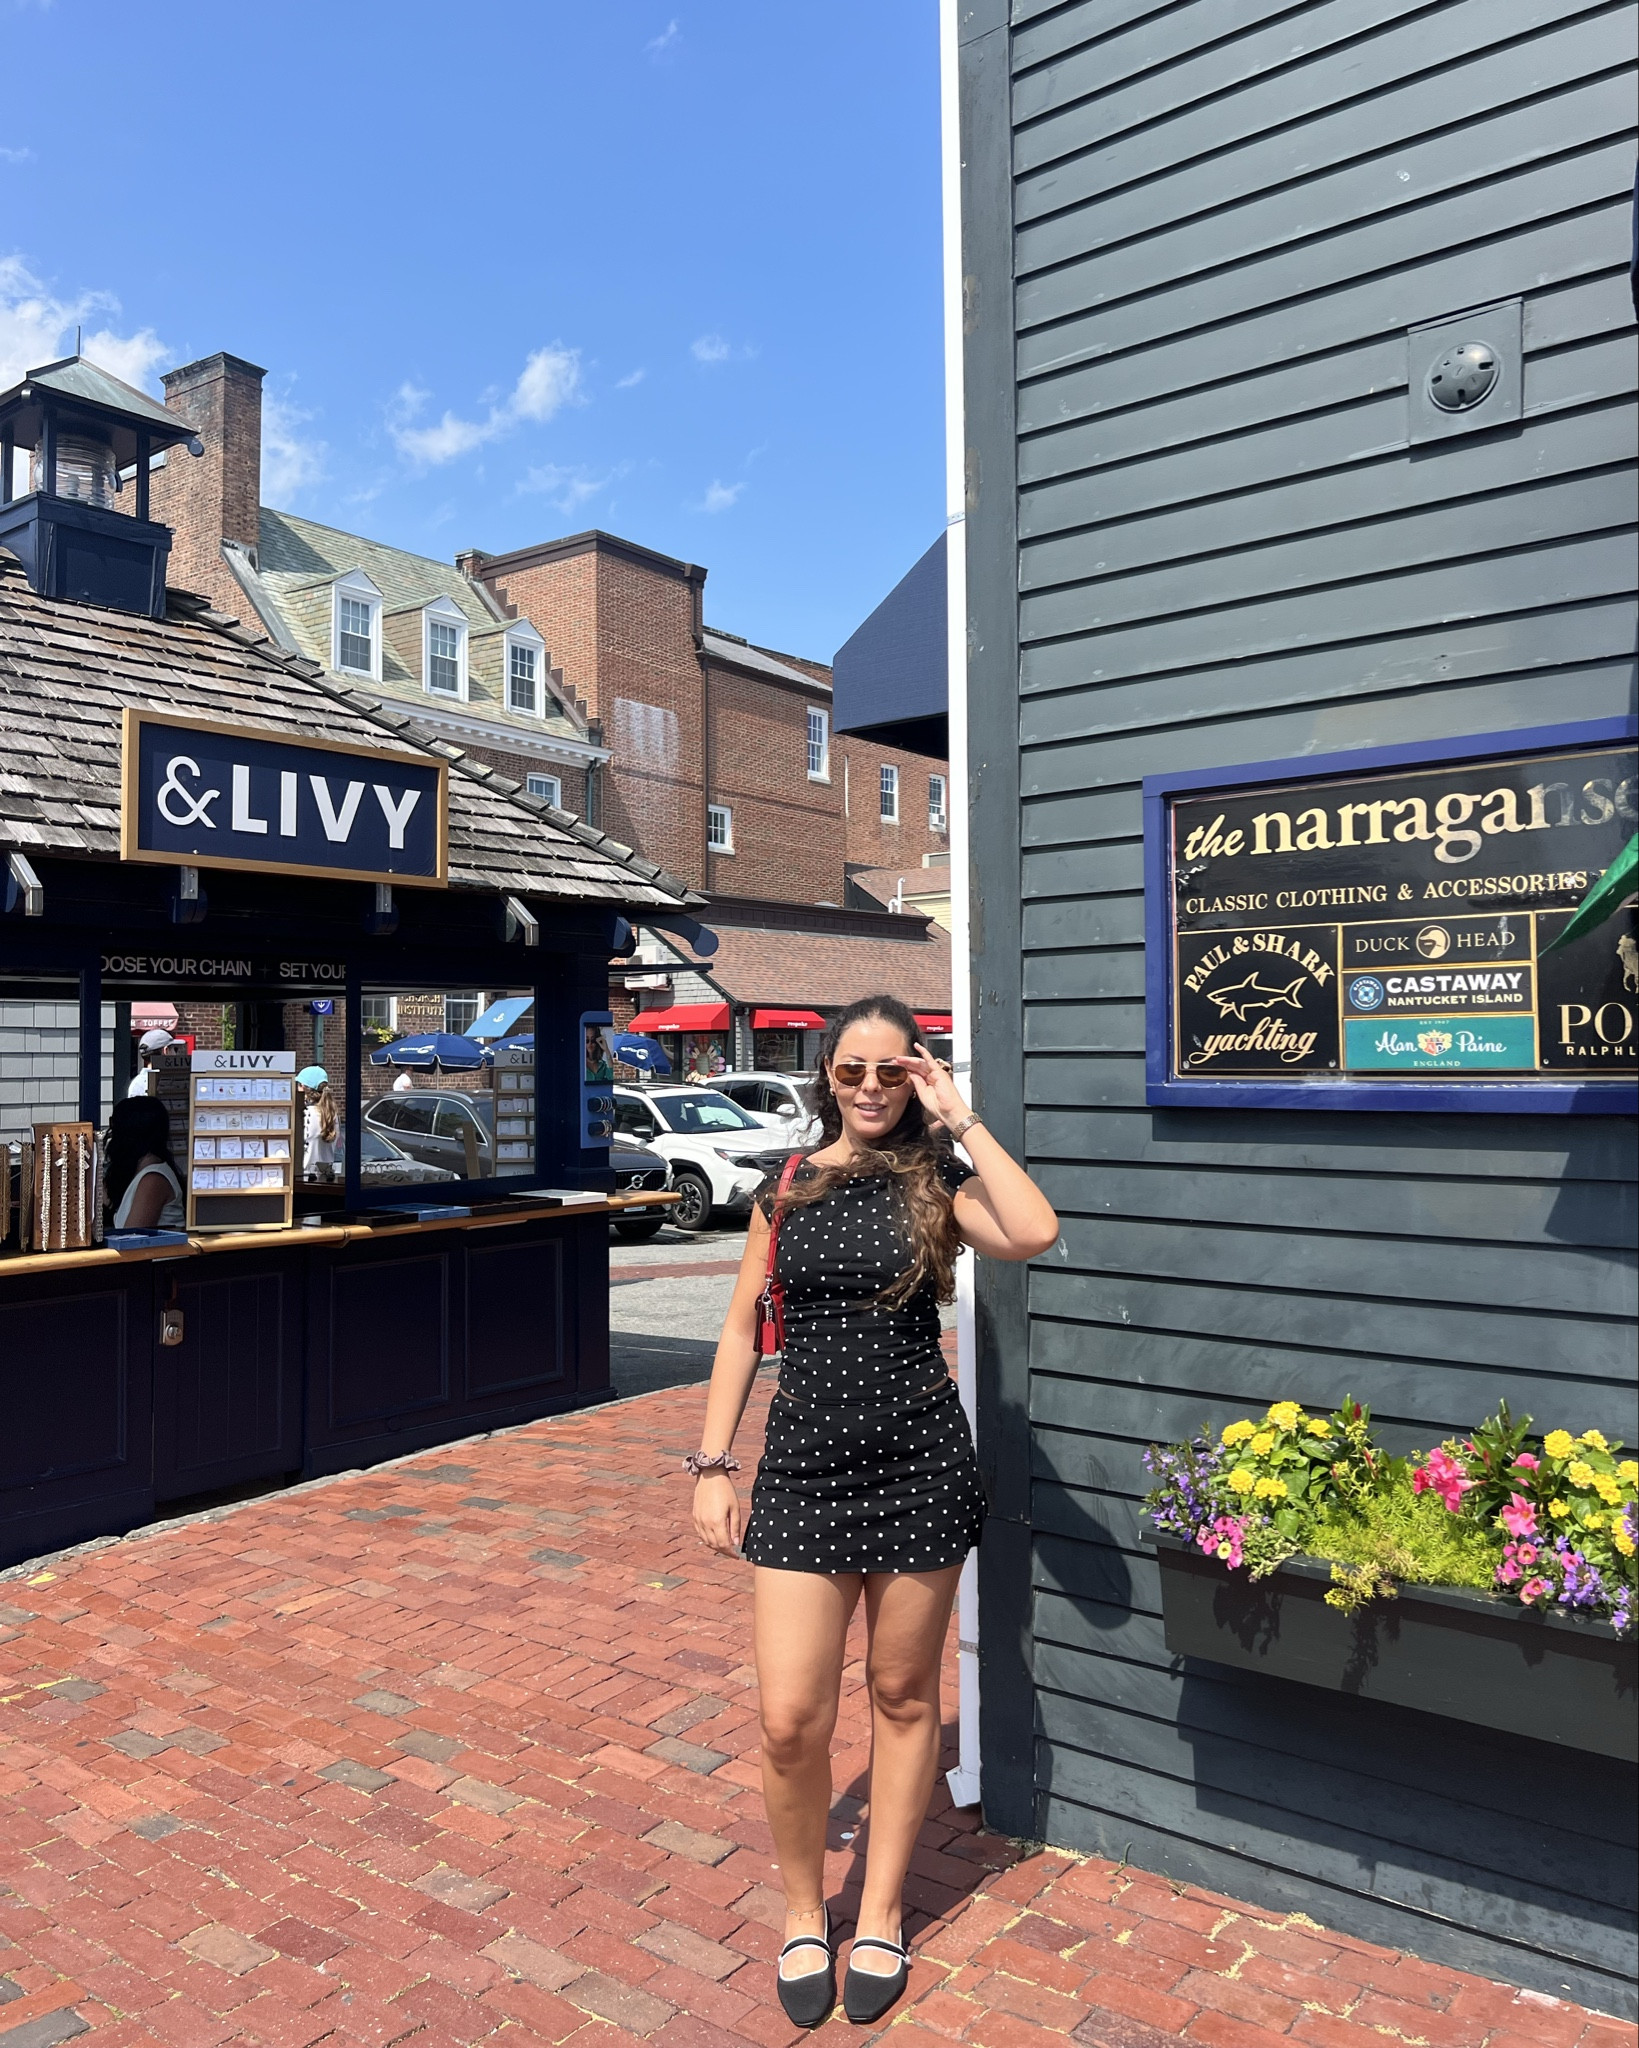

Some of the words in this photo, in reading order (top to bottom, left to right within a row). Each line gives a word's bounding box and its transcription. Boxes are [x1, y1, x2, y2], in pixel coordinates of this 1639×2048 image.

[157, 755, 422, 850] &LIVY
[1183, 813, 1246, 861] the
[1185, 892, 1269, 915] CLASSIC
[1276, 884, 1388, 909] CLOTHING
[1396, 883, 1414, 901] &
[1422, 869, 1588, 900] ACCESSORIES
[1355, 936, 1411, 953] DUCK
[1456, 930, 1516, 948] HEAD
[149, 957, 197, 975] YOUR
[199, 958, 252, 976] CHAIN
[279, 961, 309, 978] SET
[1183, 944, 1232, 994] PAUL
[1232, 935, 1250, 955] &
[1252, 932, 1336, 988] SHARK
[1385, 972, 1523, 994] CASTAWAY
[1387, 994, 1468, 1007] NANTUCKET
[1471, 992, 1523, 1004] ISLAND
[1556, 1002, 1634, 1044] PO
[1188, 1016, 1319, 1065] yachting
[1374, 1030, 1418, 1056] Alan
[1455, 1030, 1507, 1054] Paine
[1566, 1046, 1623, 1056] RALPH
[214, 1054, 274, 1068] &LIVY
[1413, 1059, 1461, 1067] ENGLAND
